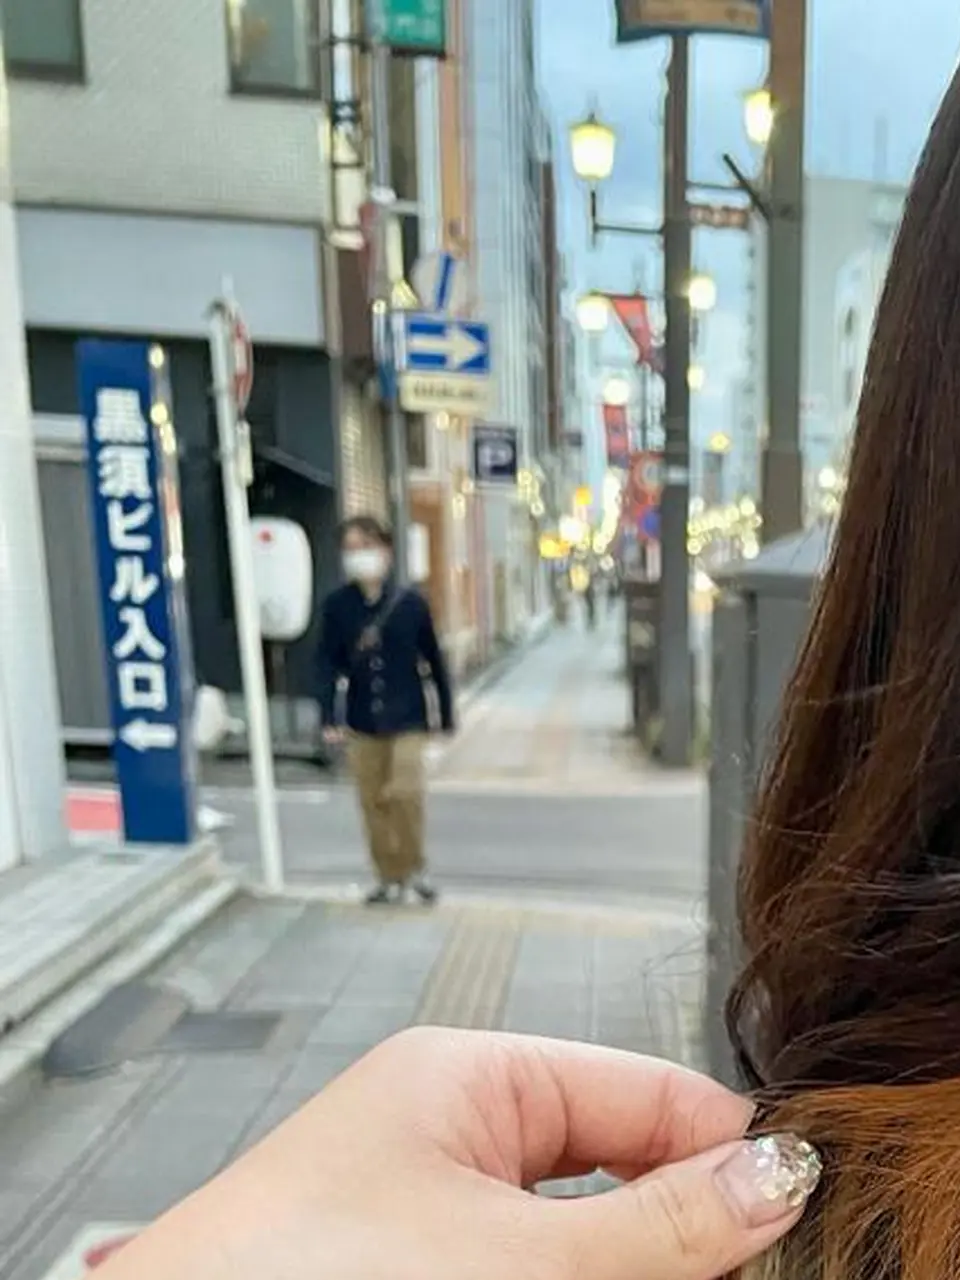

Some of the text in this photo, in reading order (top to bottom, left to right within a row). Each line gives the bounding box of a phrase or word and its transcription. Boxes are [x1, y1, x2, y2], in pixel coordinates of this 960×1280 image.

[94, 387, 166, 711] 黒須ビル入口
